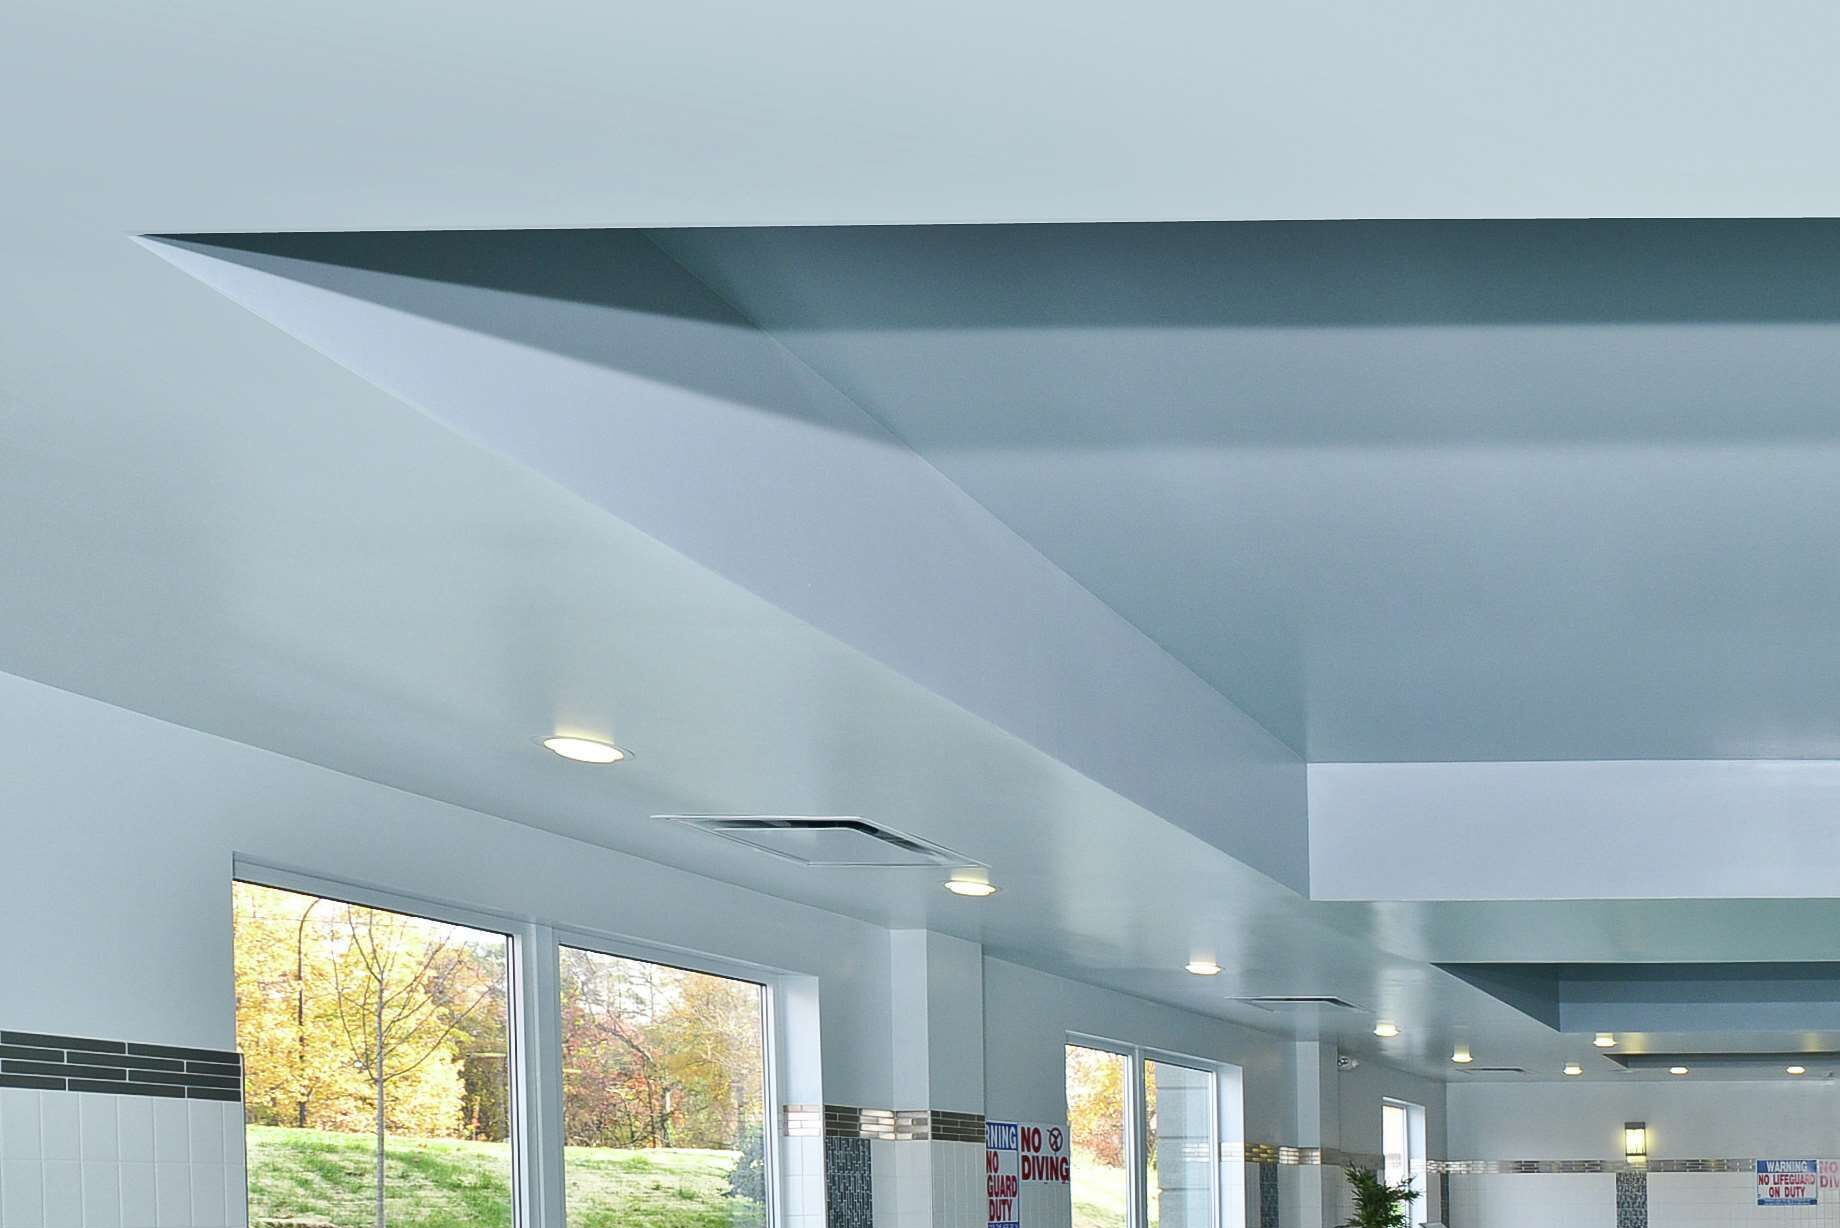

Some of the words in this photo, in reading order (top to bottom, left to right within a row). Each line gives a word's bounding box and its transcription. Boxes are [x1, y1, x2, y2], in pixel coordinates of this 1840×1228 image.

[1020, 1126, 1042, 1153] NO
[1020, 1155, 1070, 1182] DIVING
[1766, 1161, 1808, 1173] WARNING
[1819, 1161, 1839, 1174] NO
[1758, 1174, 1770, 1185] NO
[1773, 1174, 1815, 1185] LIFEGUARD
[1768, 1186, 1780, 1198] ON
[1784, 1186, 1806, 1198] DUTY
[989, 1199, 1014, 1222] DUTY
